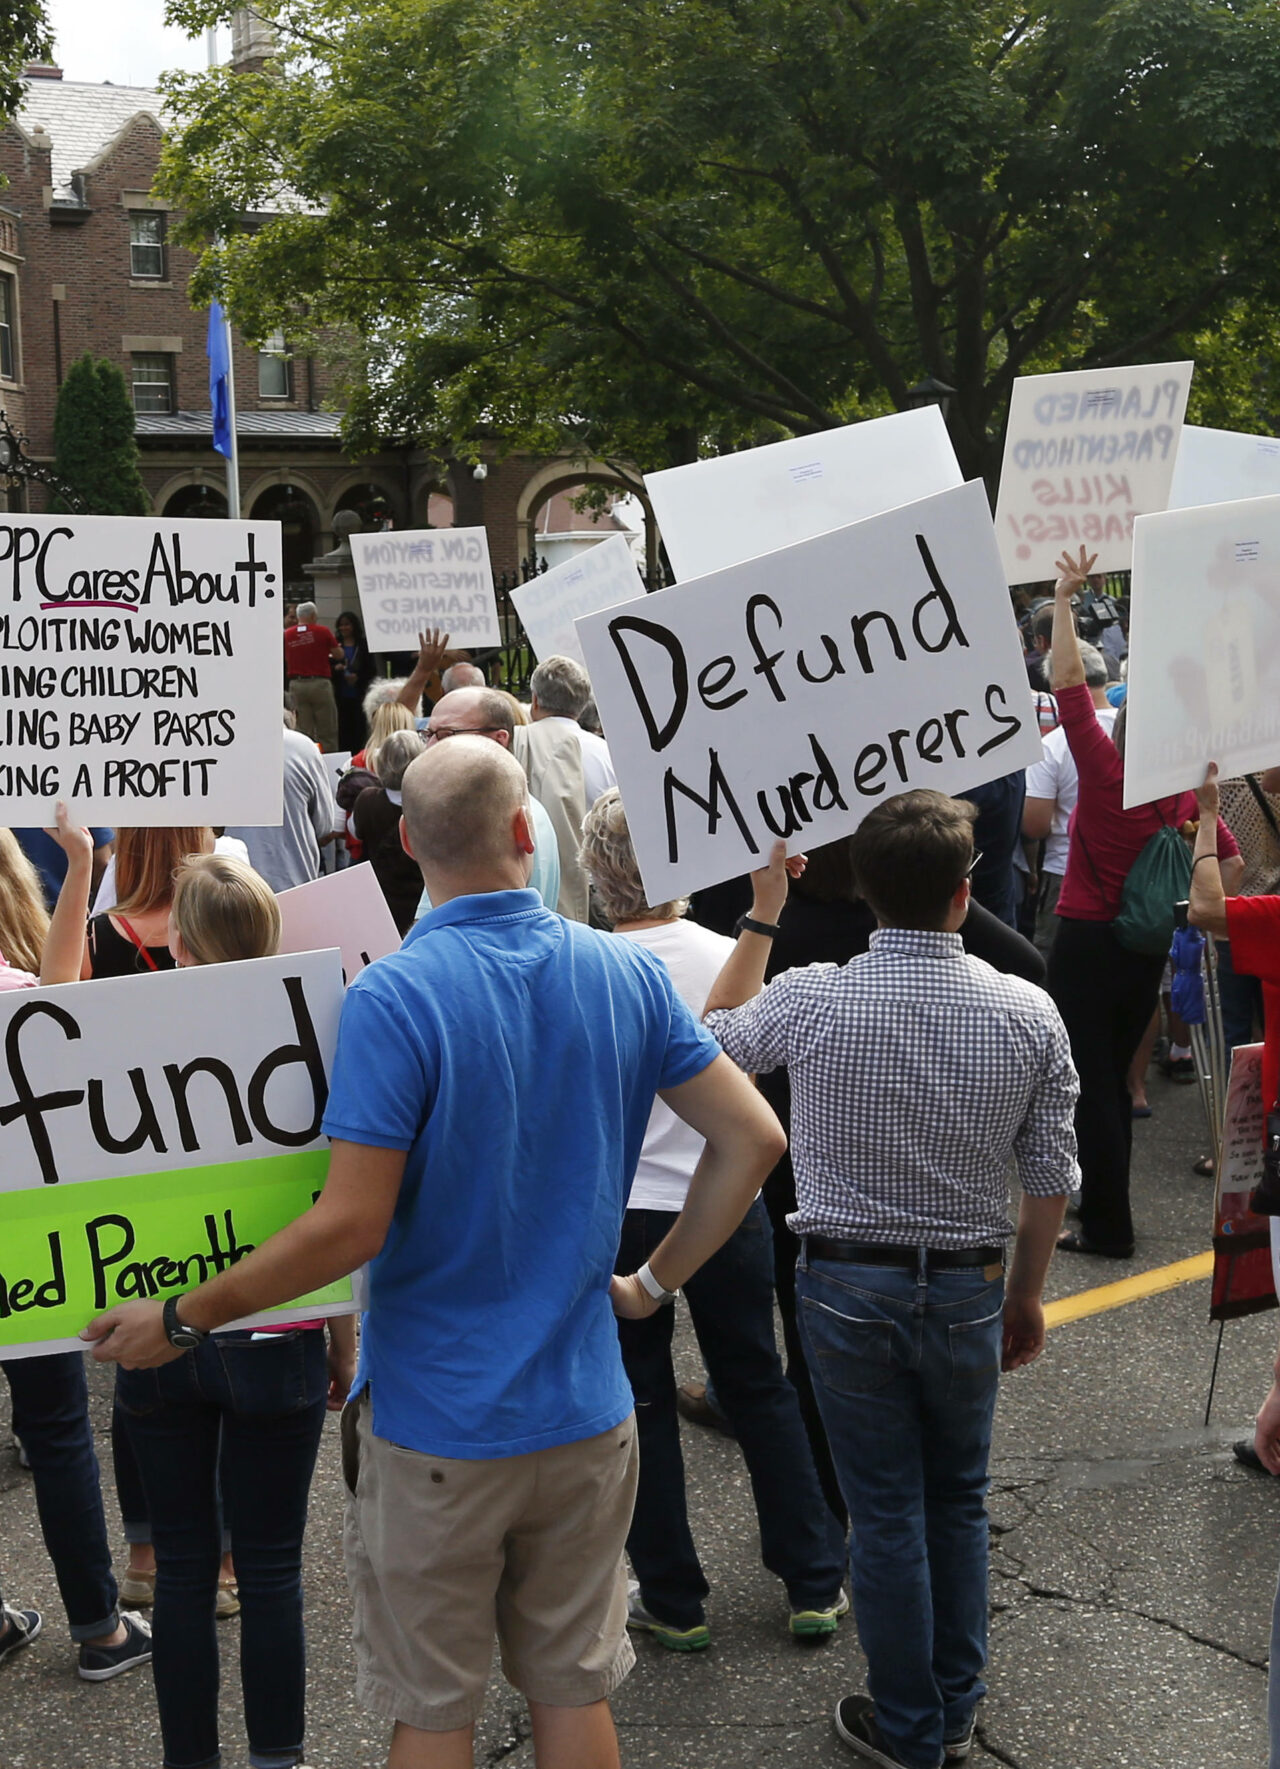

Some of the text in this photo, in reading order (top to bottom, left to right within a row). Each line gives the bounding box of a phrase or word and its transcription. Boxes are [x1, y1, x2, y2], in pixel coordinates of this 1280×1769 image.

[36, 527, 140, 602] Cares
[140, 532, 276, 608] About:
[124, 618, 234, 657] WOMEN
[608, 534, 970, 752] Defund
[60, 665, 199, 699] CHILDREN
[69, 711, 141, 747] BABY
[153, 709, 236, 747] PARTS
[71, 763, 93, 798] A
[103, 758, 218, 798] PROFIT
[663, 684, 1022, 864] Murderers
